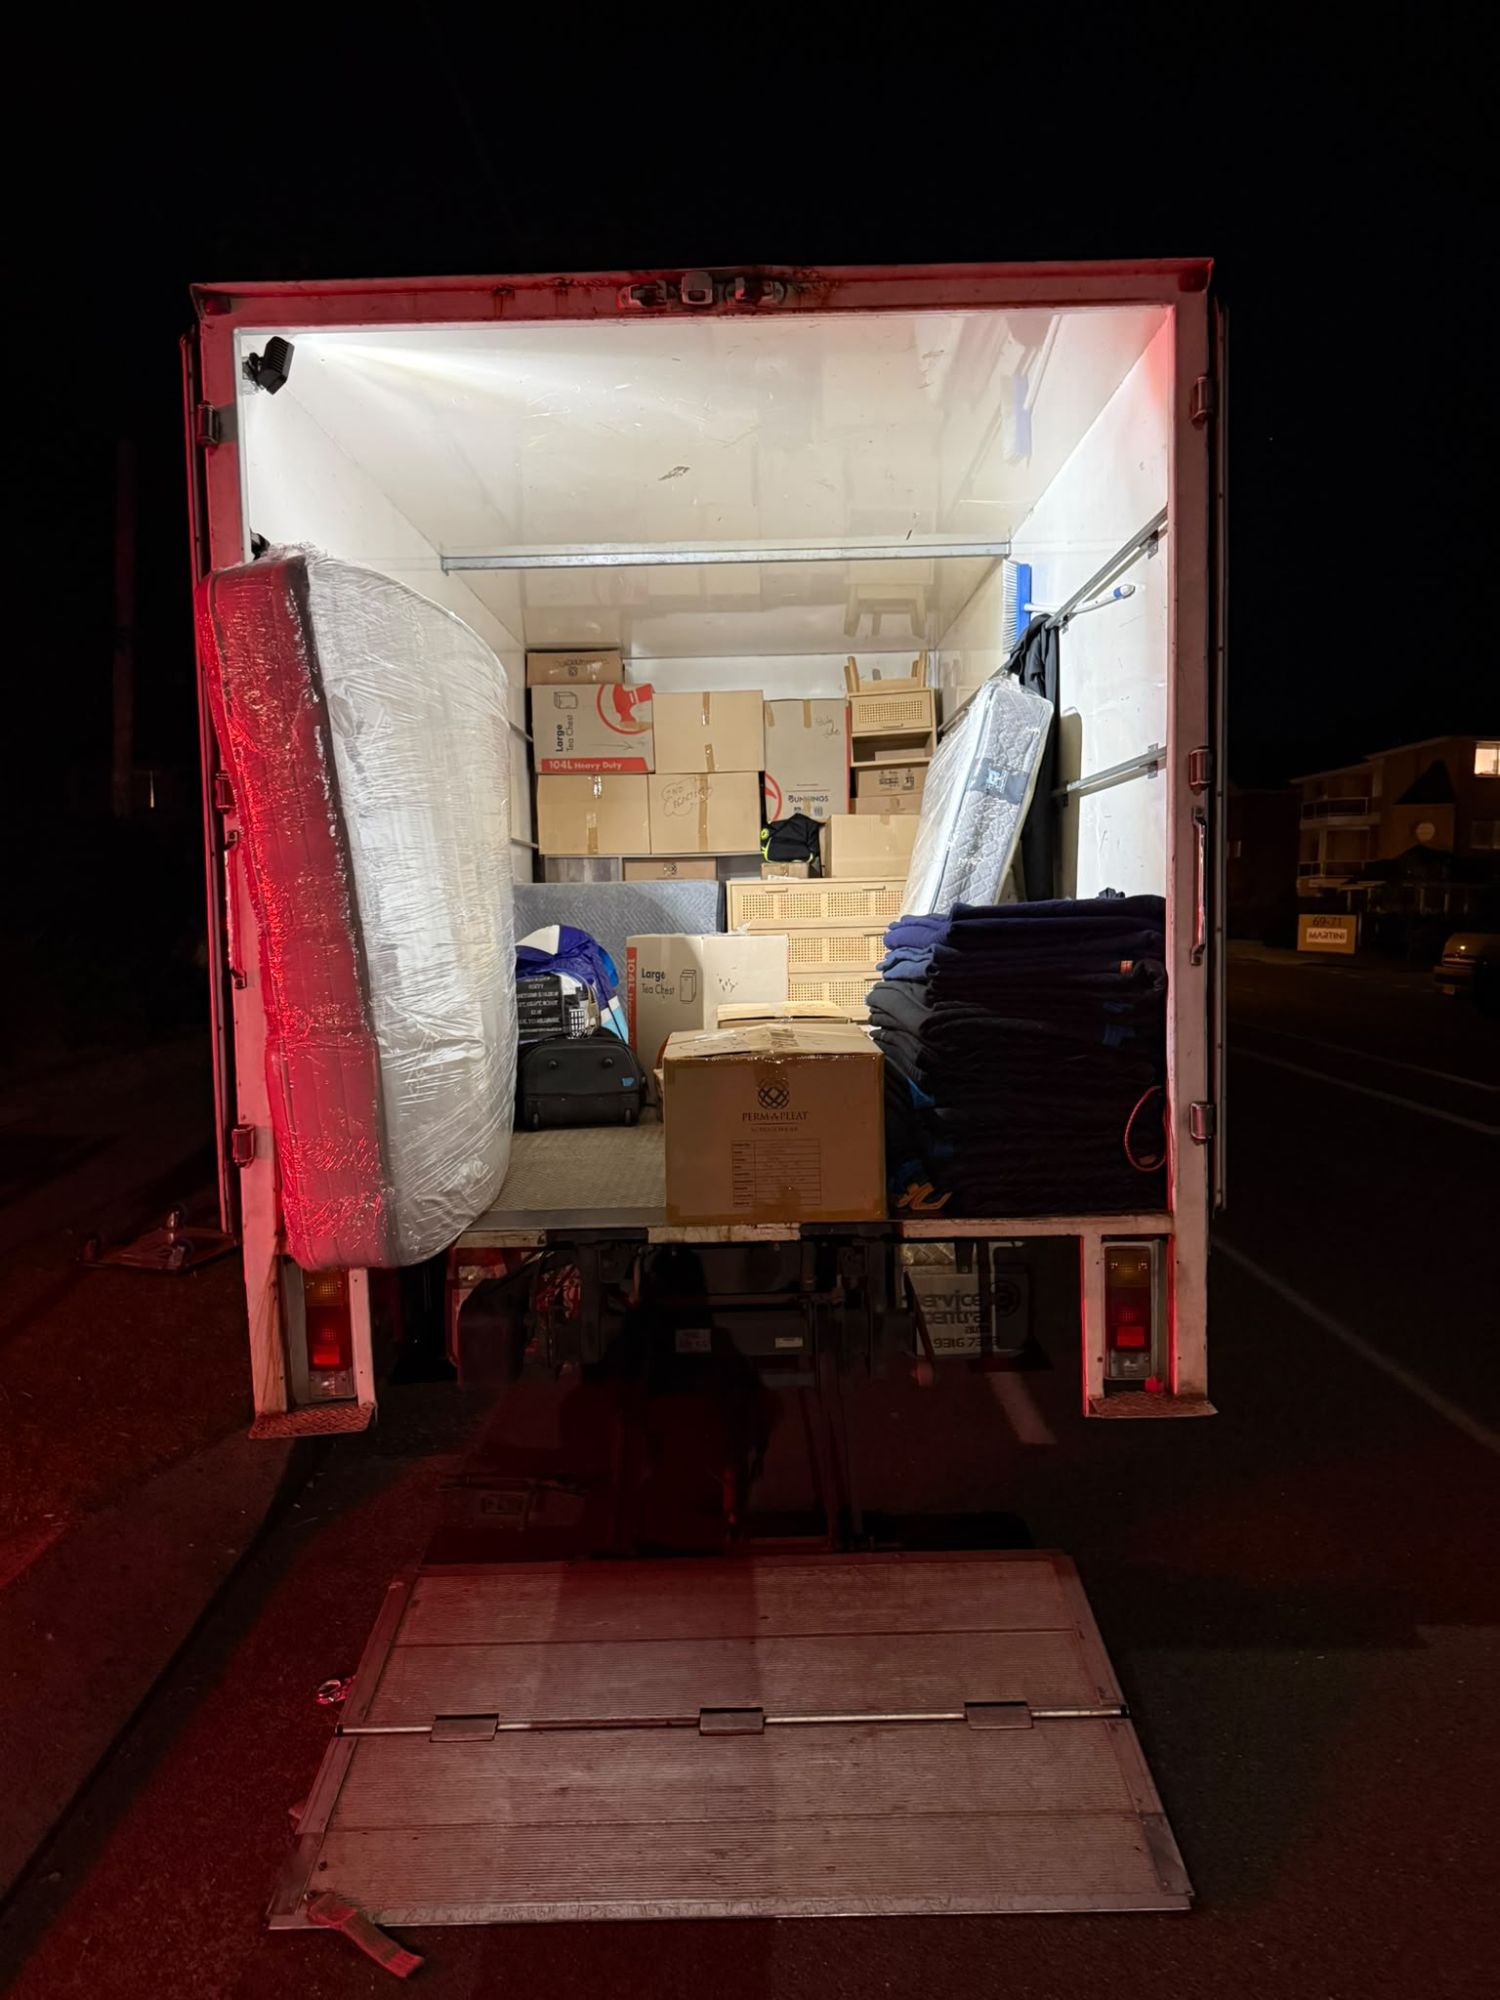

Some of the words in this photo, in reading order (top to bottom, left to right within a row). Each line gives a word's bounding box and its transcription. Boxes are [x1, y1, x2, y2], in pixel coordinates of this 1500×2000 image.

[555, 724, 565, 752] Large
[566, 738, 574, 752] Tea
[549, 760, 573, 770] 104L
[574, 762, 600, 770] Heavy
[602, 761, 622, 770] Duty
[641, 968, 665, 982] Large
[642, 983, 653, 994] Tea
[655, 983, 674, 995] Chest
[922, 1290, 983, 1309] ervice
